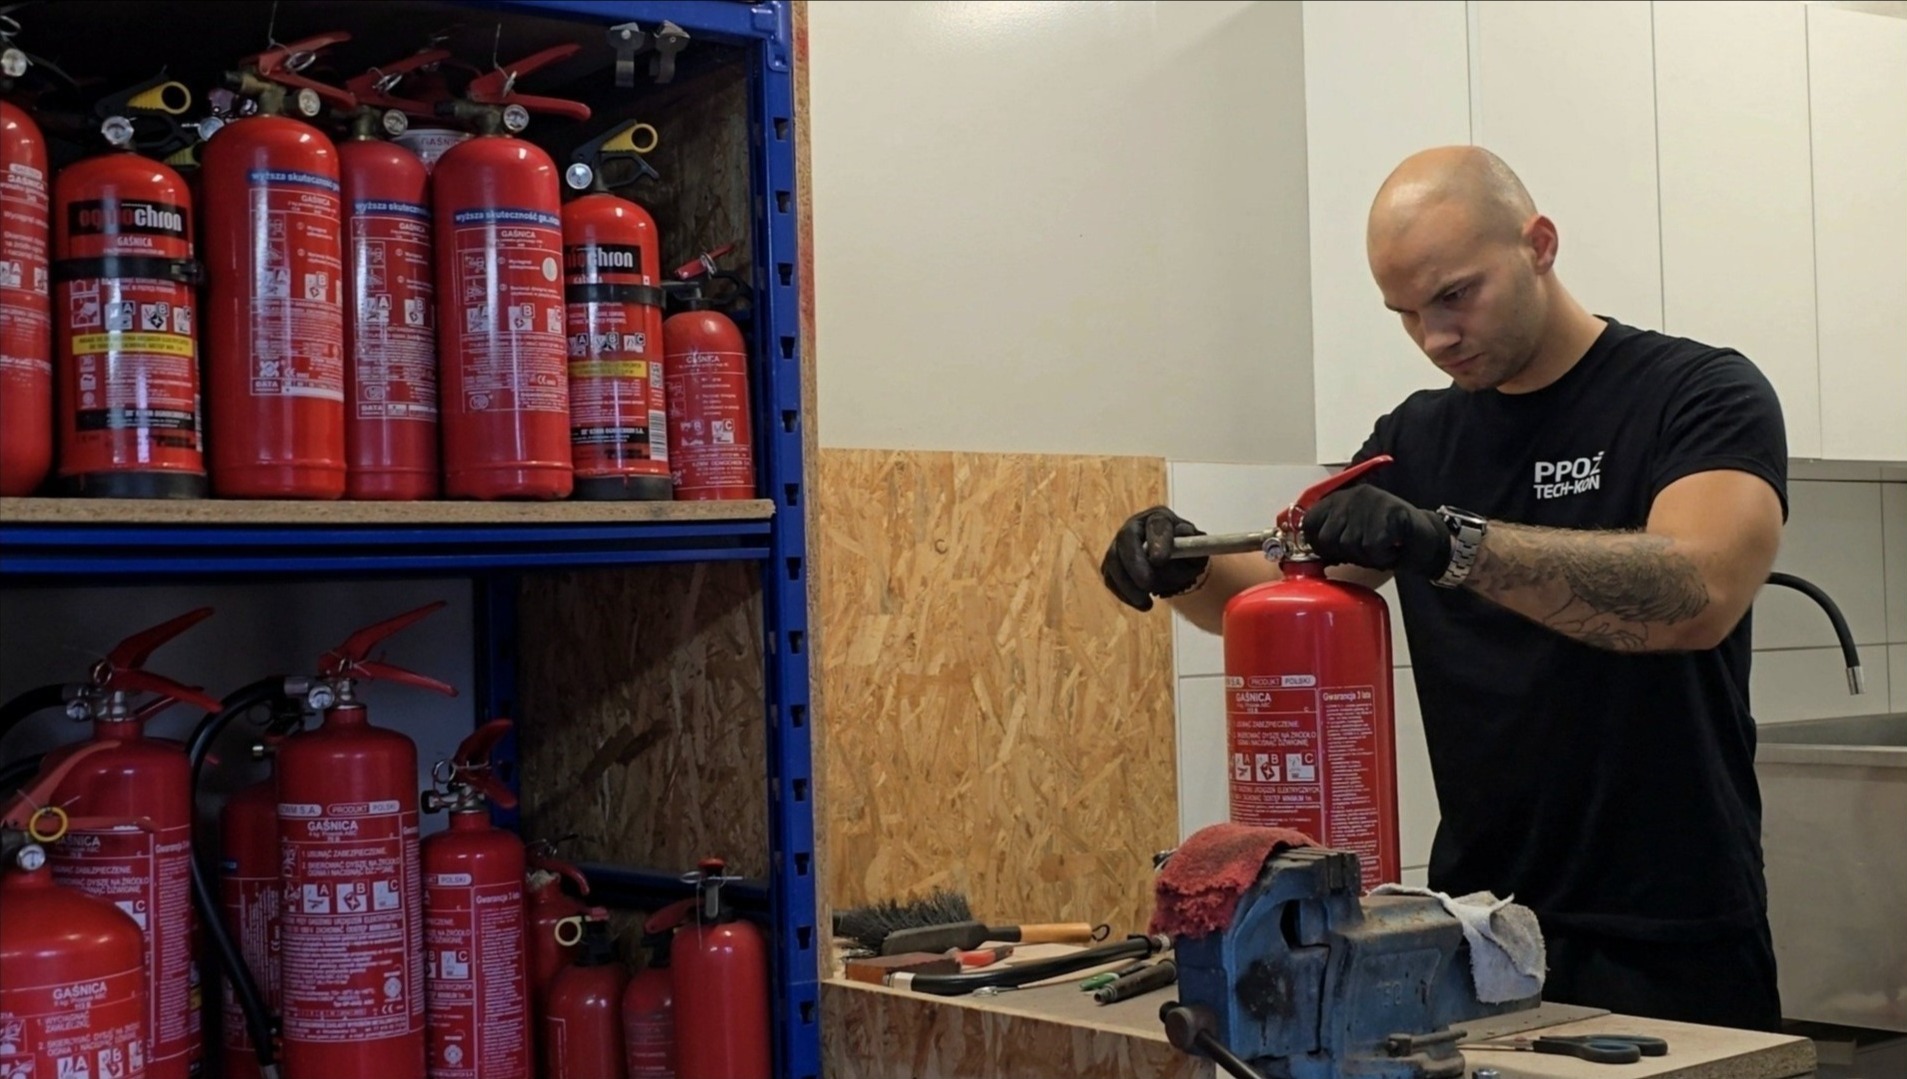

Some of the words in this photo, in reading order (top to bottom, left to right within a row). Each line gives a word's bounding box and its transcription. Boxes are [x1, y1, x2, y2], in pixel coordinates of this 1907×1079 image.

[455, 211, 485, 222] wyższa
[117, 235, 153, 248] GAŚNICA
[522, 304, 533, 316] B
[725, 421, 734, 431] C
[1533, 475, 1601, 500] TECH-KON
[1284, 677, 1312, 686] POLSKI
[1235, 691, 1272, 703] GAŚNICA
[1323, 692, 1357, 701] Gwarancja
[1270, 754, 1280, 764] B
[1303, 753, 1314, 764] C
[331, 804, 368, 814] PRODUKT
[371, 803, 396, 812] POLSKI
[306, 819, 359, 832] GAŚNICA
[440, 876, 468, 885] POLSKI
[319, 884, 330, 896] A
[355, 882, 366, 895] B
[389, 880, 399, 891] C
[475, 893, 508, 904] Gwarancja
[135, 900, 146, 912] C
[458, 949, 468, 961] C
[53, 981, 107, 1000] GAŚNICA
[75, 1056, 88, 1071] A
[112, 1048, 122, 1062] B
